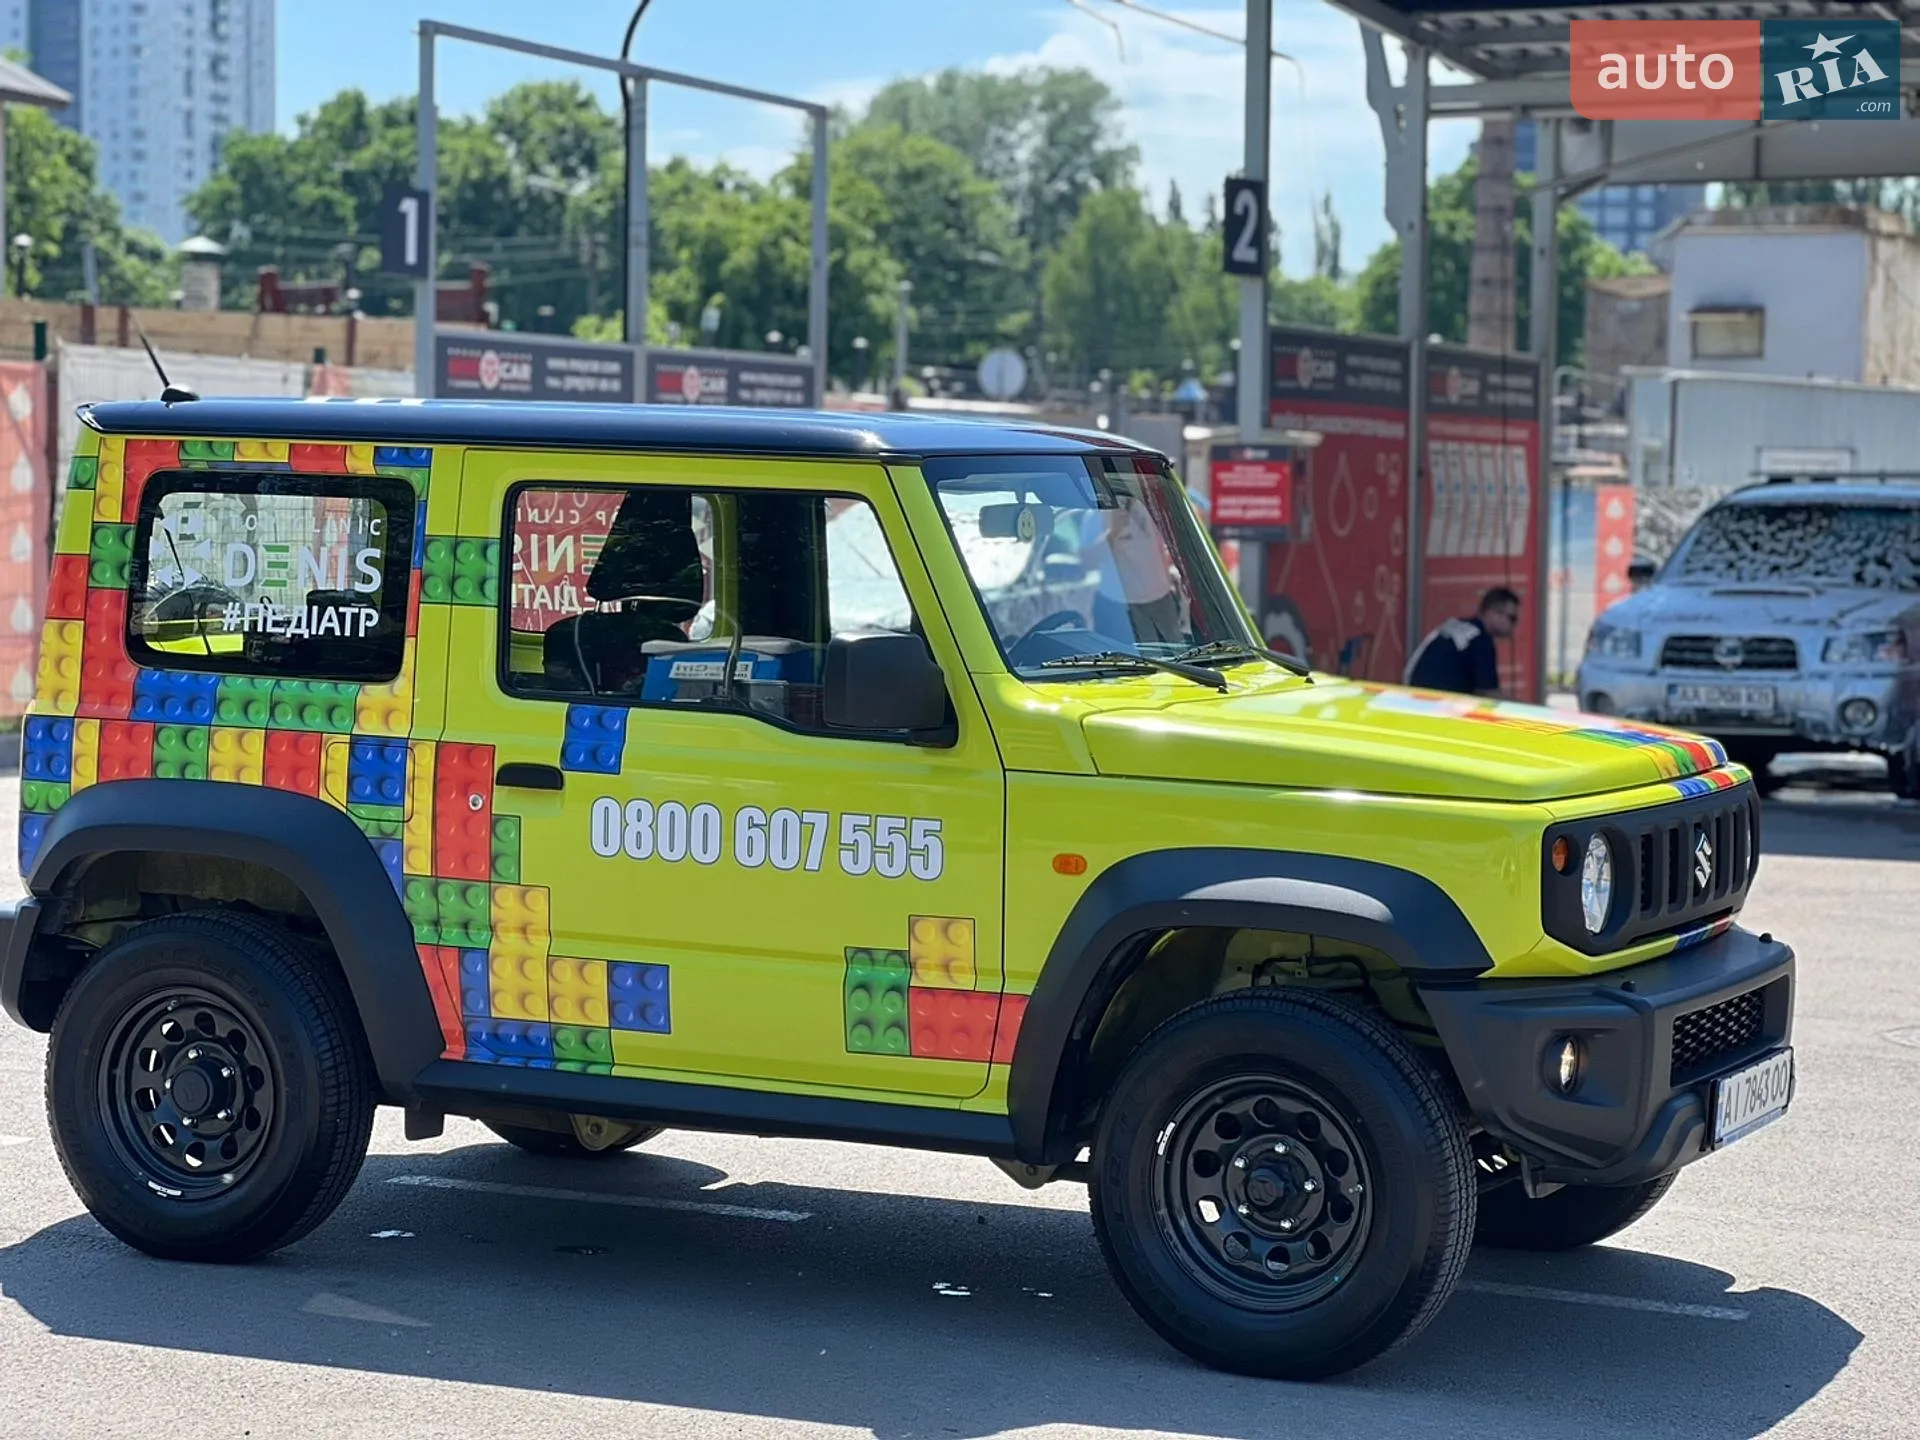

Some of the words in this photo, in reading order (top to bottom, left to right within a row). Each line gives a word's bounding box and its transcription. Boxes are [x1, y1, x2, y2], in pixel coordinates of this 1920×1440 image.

[398, 197, 419, 266] 1
[1232, 189, 1259, 263] 2
[224, 543, 382, 594] DENIS
[591, 796, 722, 864] 0800
[734, 806, 829, 872] 607
[839, 812, 944, 881] 555
